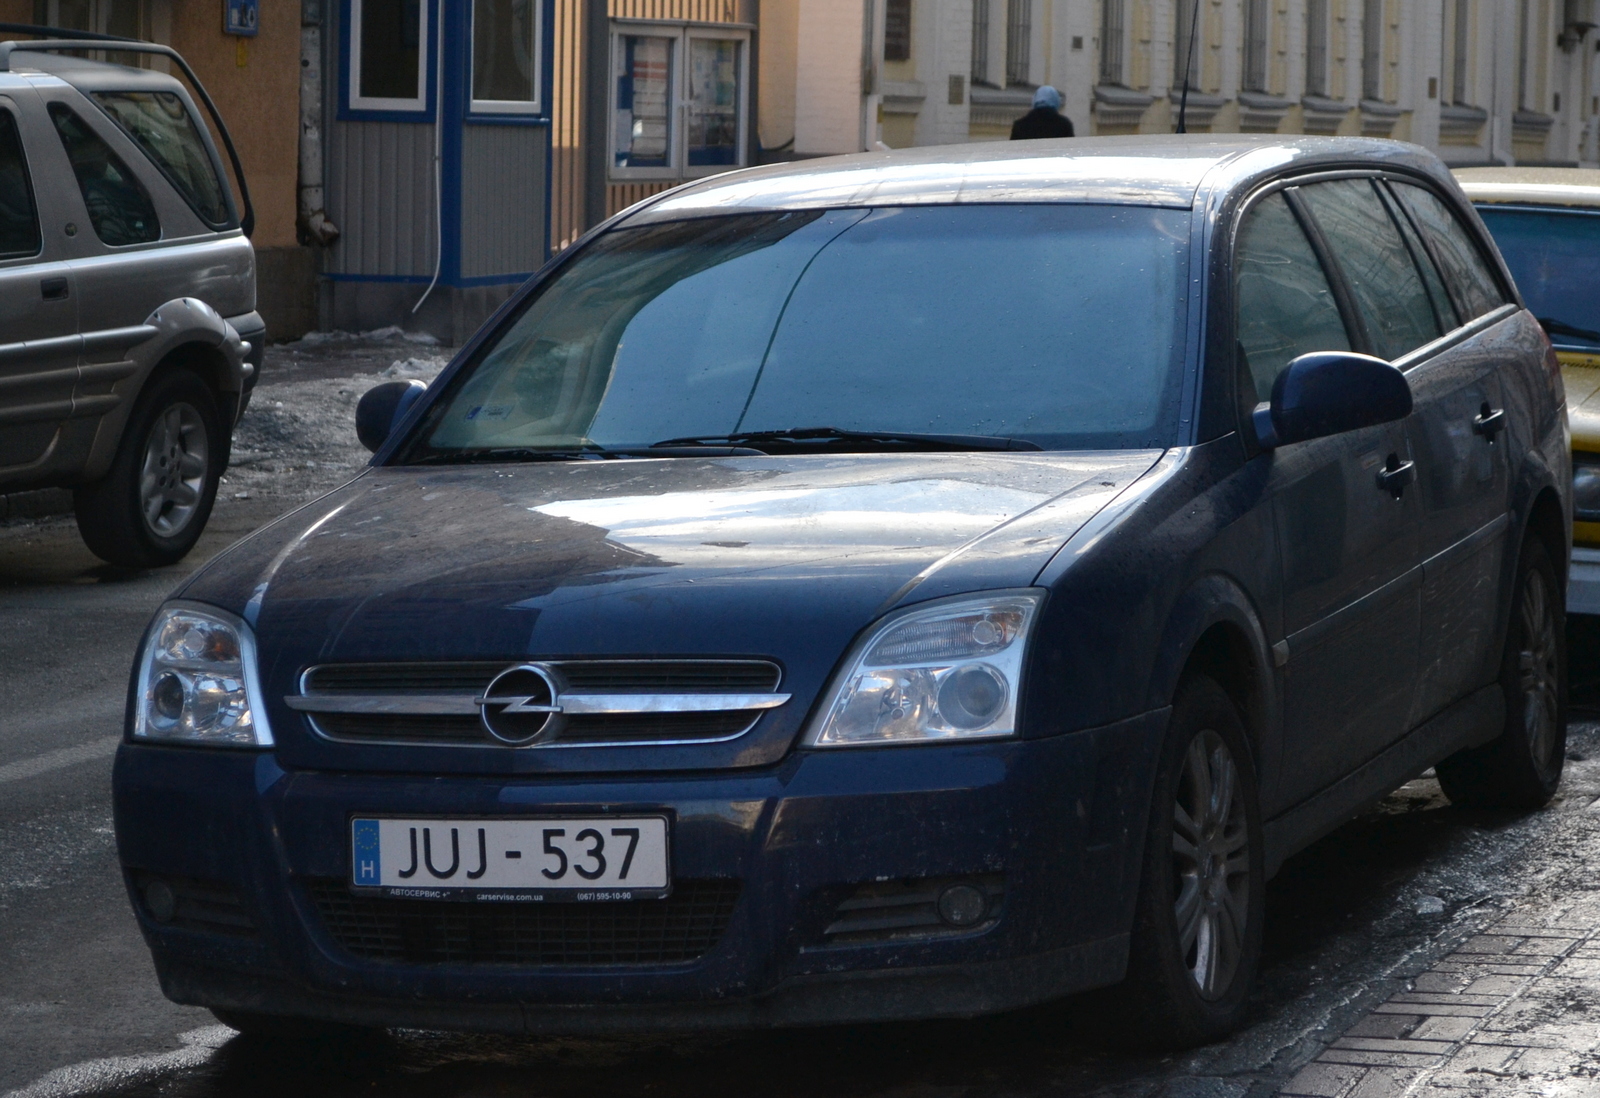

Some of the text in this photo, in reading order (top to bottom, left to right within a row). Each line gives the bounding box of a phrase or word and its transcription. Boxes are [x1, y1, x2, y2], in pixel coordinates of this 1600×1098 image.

[361, 860, 374, 878] H
[476, 893, 544, 902] carservise.com.ua
[577, 892, 632, 901] (067) 595-10-90
